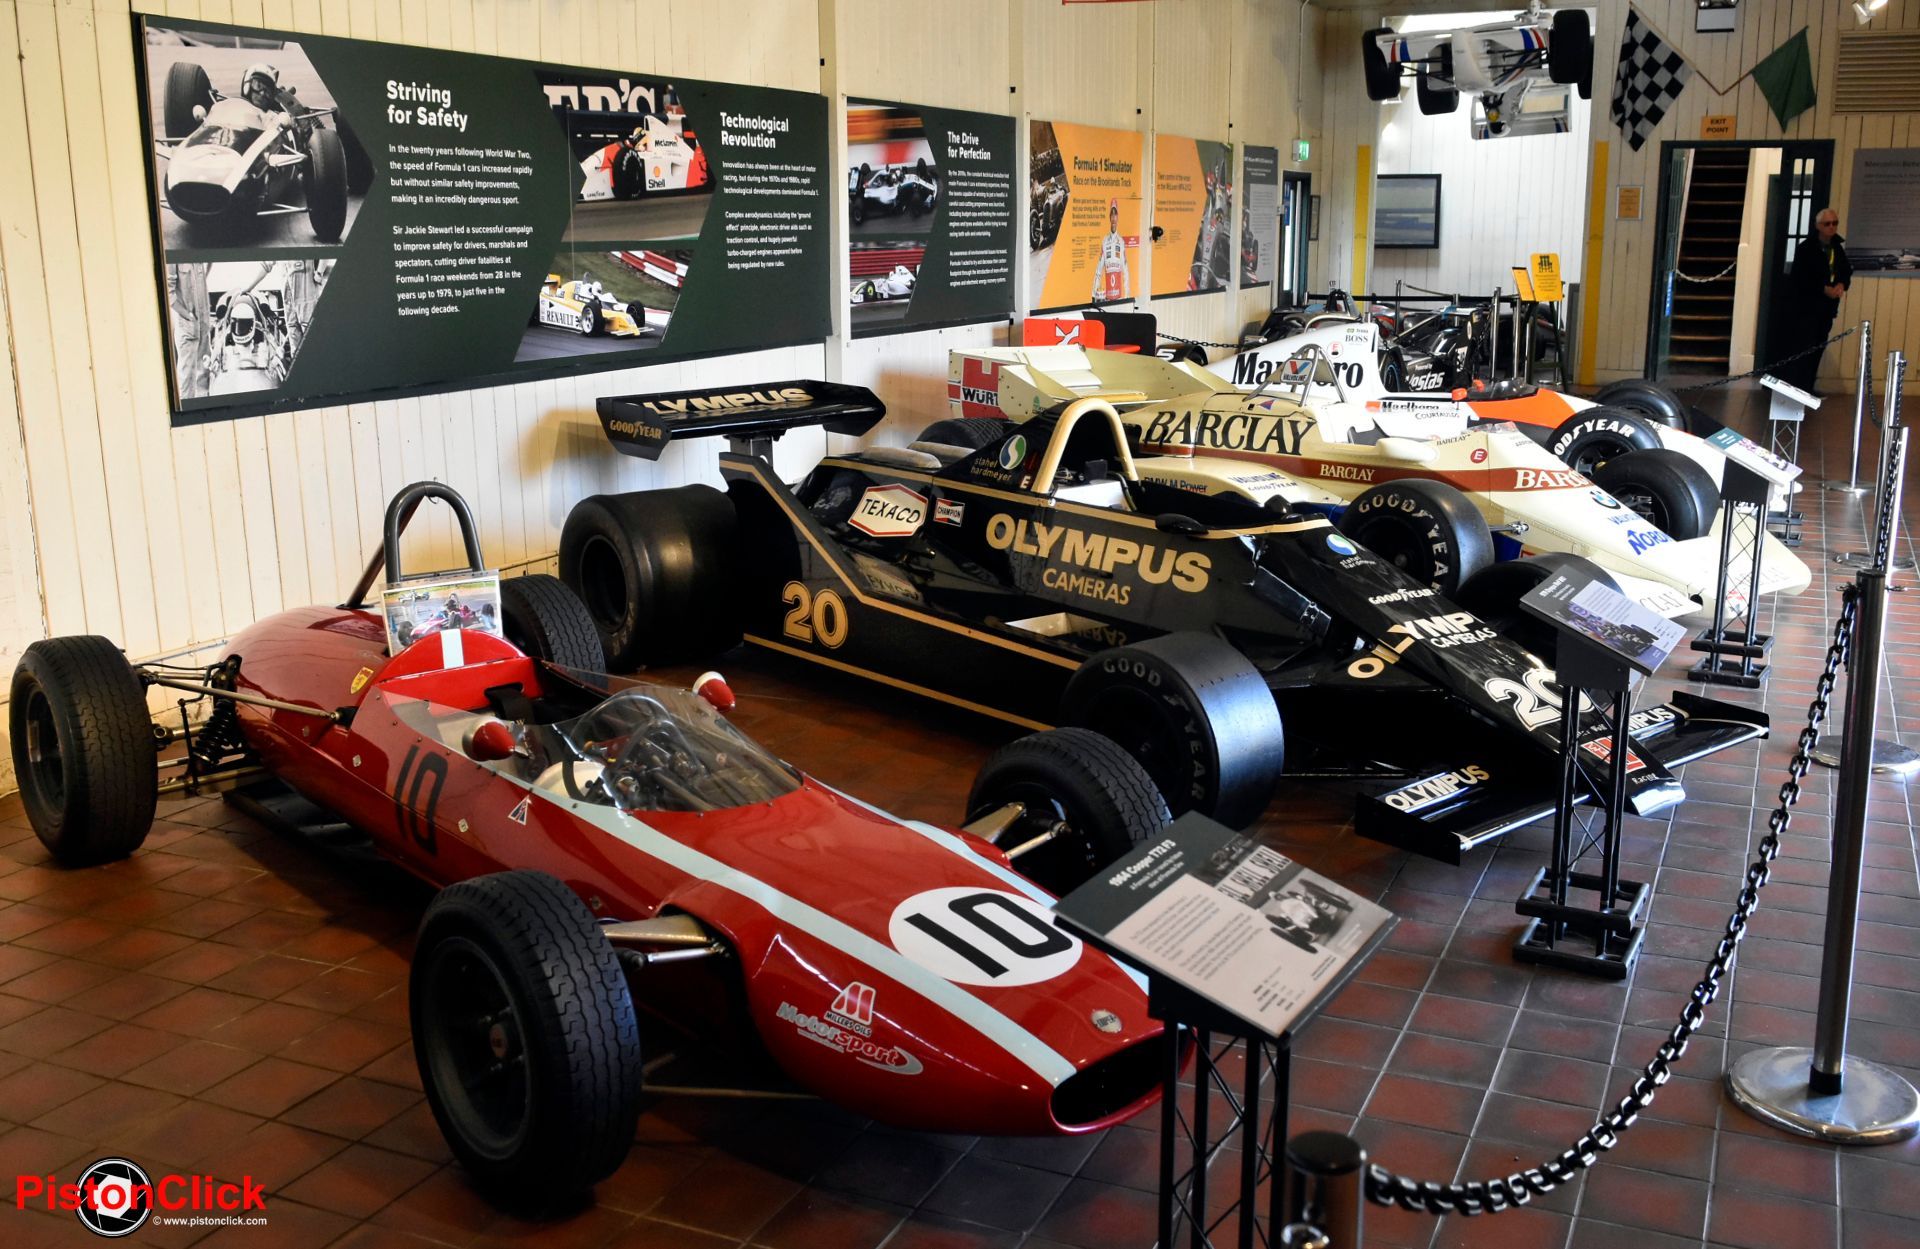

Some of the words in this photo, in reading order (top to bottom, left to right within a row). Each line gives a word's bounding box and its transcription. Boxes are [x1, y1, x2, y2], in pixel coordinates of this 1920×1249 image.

[386, 80, 451, 108] Striving
[387, 104, 412, 124] for
[417, 106, 468, 132] Safety
[719, 112, 789, 134] Technological
[721, 130, 776, 148] Revolution
[947, 131, 960, 144] The
[961, 132, 979, 146] Drive
[389, 144, 396, 153] In
[397, 144, 409, 153] the
[410, 145, 434, 156] twenty
[435, 147, 454, 156] years
[455, 147, 484, 159] following
[485, 149, 503, 158] World
[504, 149, 516, 158] War
[517, 150, 531, 160] Two,
[947, 146, 958, 158] for
[959, 146, 991, 160] Perfection
[390, 161, 401, 170] the
[403, 161, 424, 172] speed
[426, 162, 433, 171] of
[434, 162, 462, 172] Formula
[462, 163, 466, 172] 1
[481, 164, 511, 173] increased
[513, 165, 533, 176] rapidly
[1073, 156, 1098, 172] Formula
[1099, 158, 1103, 171] 1
[1104, 159, 1132, 174] Simulator
[390, 178, 403, 186] but
[404, 178, 430, 187] without
[431, 179, 453, 187] similar
[454, 179, 474, 190] safety
[475, 180, 520, 190] improvements,
[648, 179, 666, 189] Shell
[391, 194, 417, 205] making
[418, 194, 424, 203] it
[435, 194, 467, 205] incredibly
[468, 195, 501, 206] dangerous
[502, 196, 519, 205] sport.
[392, 225, 403, 234] Sir
[404, 226, 427, 234] Jackie
[427, 225, 453, 234] Stewart
[454, 225, 465, 234] led
[471, 225, 504, 234] successful
[505, 225, 533, 235] campaign
[393, 242, 401, 251] to
[403, 242, 431, 252] improve
[432, 241, 452, 251] safety
[454, 241, 463, 250] for
[464, 241, 488, 250] drivers,
[488, 240, 515, 249] marshals
[517, 240, 528, 248] and
[395, 258, 433, 269] spectators,
[434, 257, 457, 267] cutting
[458, 257, 477, 265] driver
[478, 256, 504, 264] fatalities
[396, 274, 424, 284] Formula
[425, 274, 429, 282] 1
[446, 272, 478, 281] weekends
[479, 271, 494, 280] from
[511, 270, 521, 278] the
[397, 291, 416, 301] years
[417, 291, 426, 301] up
[428, 290, 435, 298] to
[455, 289, 461, 297] to
[462, 288, 475, 298] just
[475, 287, 487, 295] five
[495, 286, 505, 294] the
[398, 306, 430, 316] following
[431, 305, 460, 314] decades.
[546, 310, 574, 326] RENAULT
[1231, 352, 1364, 388] Maro
[643, 388, 815, 415] LYMPUS
[962, 387, 999, 406] WÜRT
[1382, 401, 1439, 410] Marlboro
[609, 419, 663, 440] GOODYEAR
[1142, 410, 1317, 456] BARCLAY
[1554, 418, 1635, 456] ODYEAR
[1436, 434, 1467, 446] BARCLAY
[974, 457, 999, 469] stahel
[970, 466, 1013, 482] hardmeyer
[1320, 464, 1375, 481] BARCLAY
[1019, 475, 1031, 489] E
[1169, 479, 1178, 489] M
[1180, 480, 1208, 493] Power
[860, 498, 921, 524] TEXACO
[937, 505, 962, 519] CHAMPION
[985, 513, 1213, 593] OLYMPUS
[1358, 494, 1449, 595] GOODYEAR
[1042, 568, 1131, 606] CAMERAS
[1368, 588, 1435, 605] GOODYEAR
[782, 579, 849, 649] 20
[1347, 612, 1476, 679] OLYMP
[1430, 627, 1498, 649] CAMERAS
[1384, 765, 1490, 812] OLYMPUS
[393, 744, 448, 857] 10
[1126, 855, 1155, 875] Cooper
[903, 892, 1074, 979] 10
[776, 1001, 900, 1066] Motorsport
[826, 1012, 853, 1029] MILLERS
[854, 1024, 872, 1037] OILS
